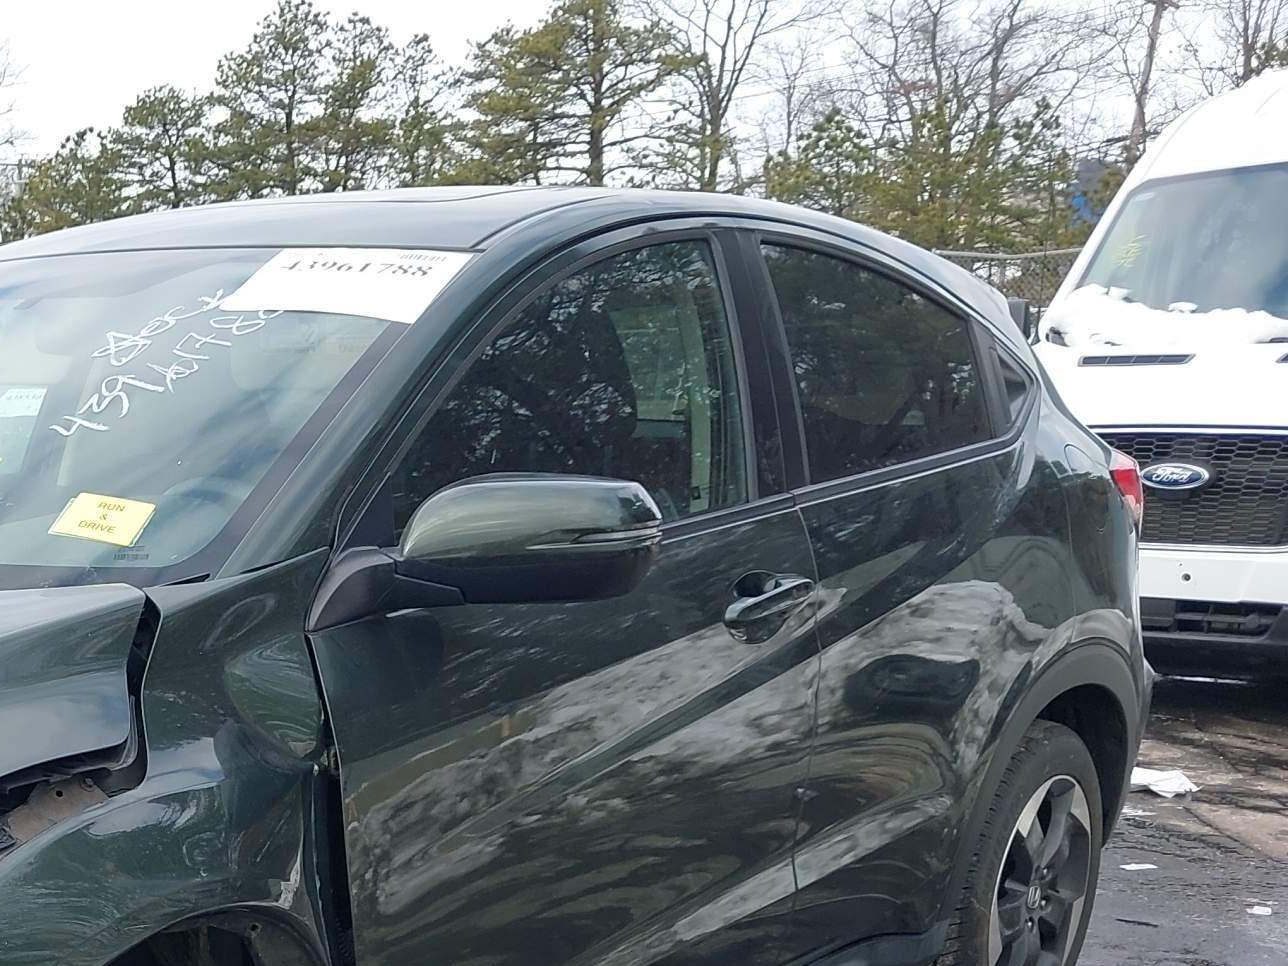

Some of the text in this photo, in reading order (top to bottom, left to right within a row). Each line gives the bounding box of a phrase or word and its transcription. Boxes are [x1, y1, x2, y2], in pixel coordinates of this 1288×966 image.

[1151, 466, 1194, 483] Ford
[97, 501, 126, 512] RUN
[77, 519, 117, 534] DRIVE
